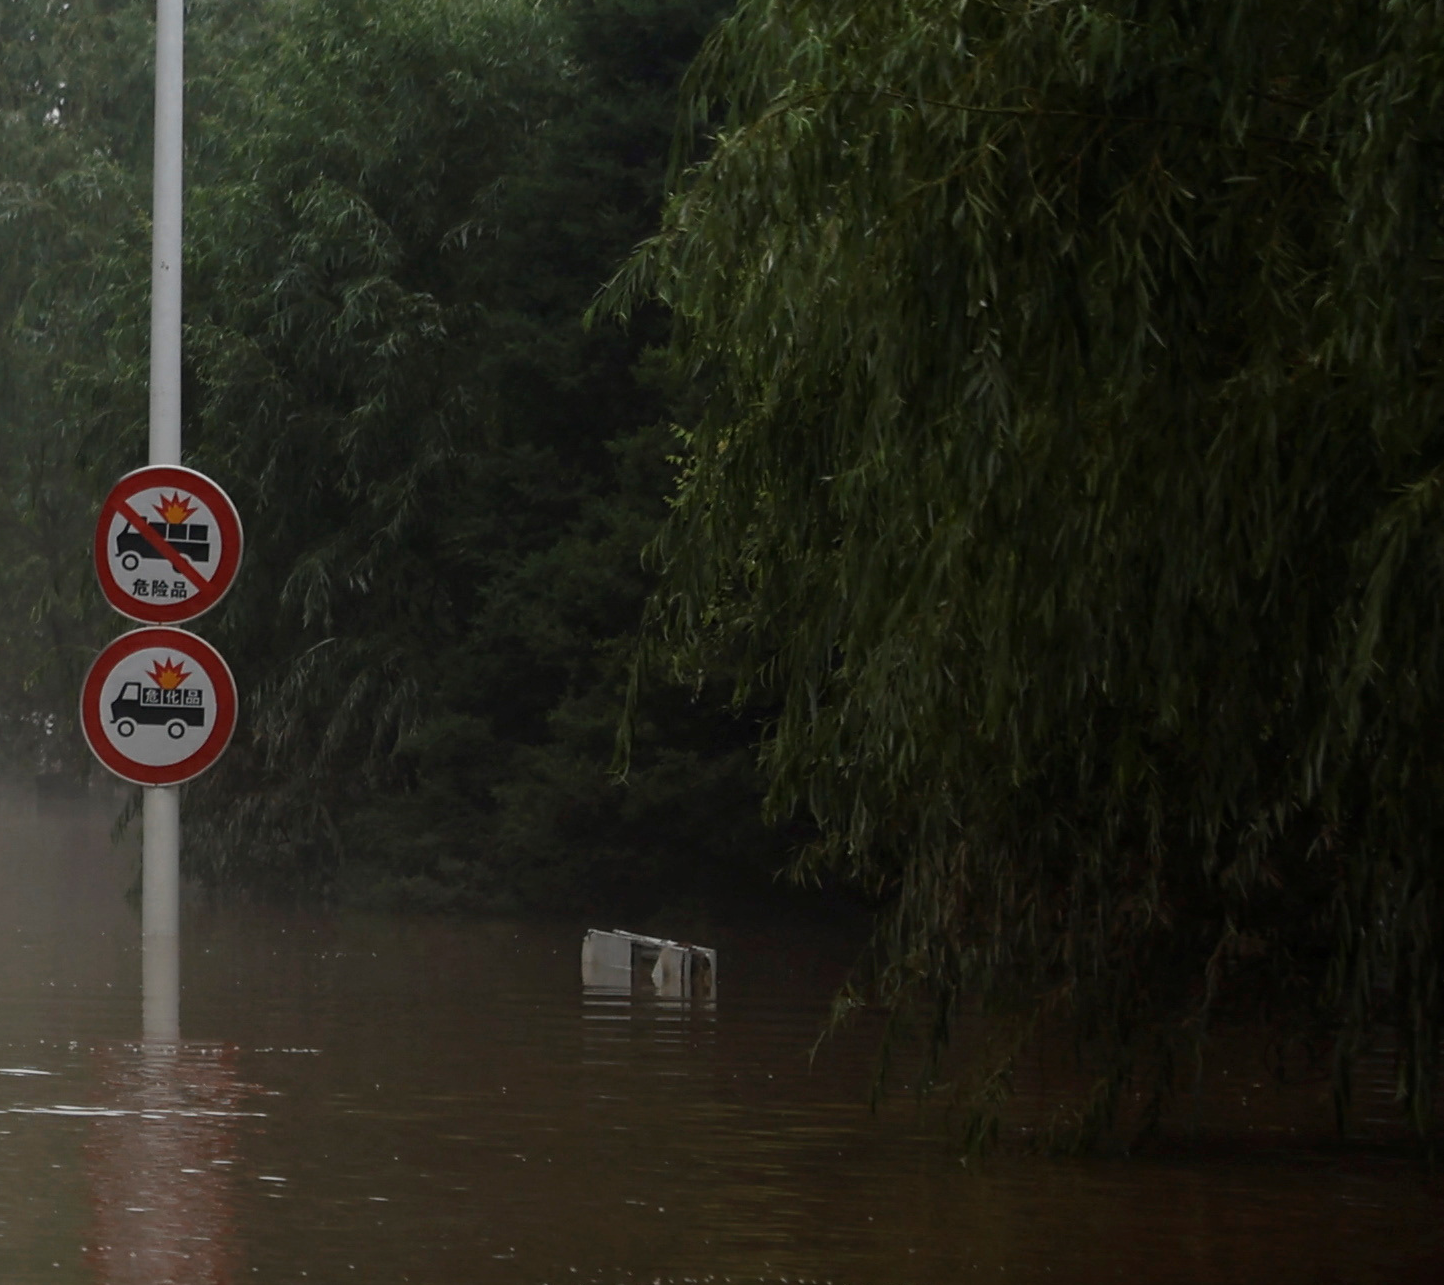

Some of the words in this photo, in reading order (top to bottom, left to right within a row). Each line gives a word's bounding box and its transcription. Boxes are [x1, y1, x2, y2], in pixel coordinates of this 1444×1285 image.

[132, 578, 188, 599] 危险品
[145, 689, 200, 705] 危化品
